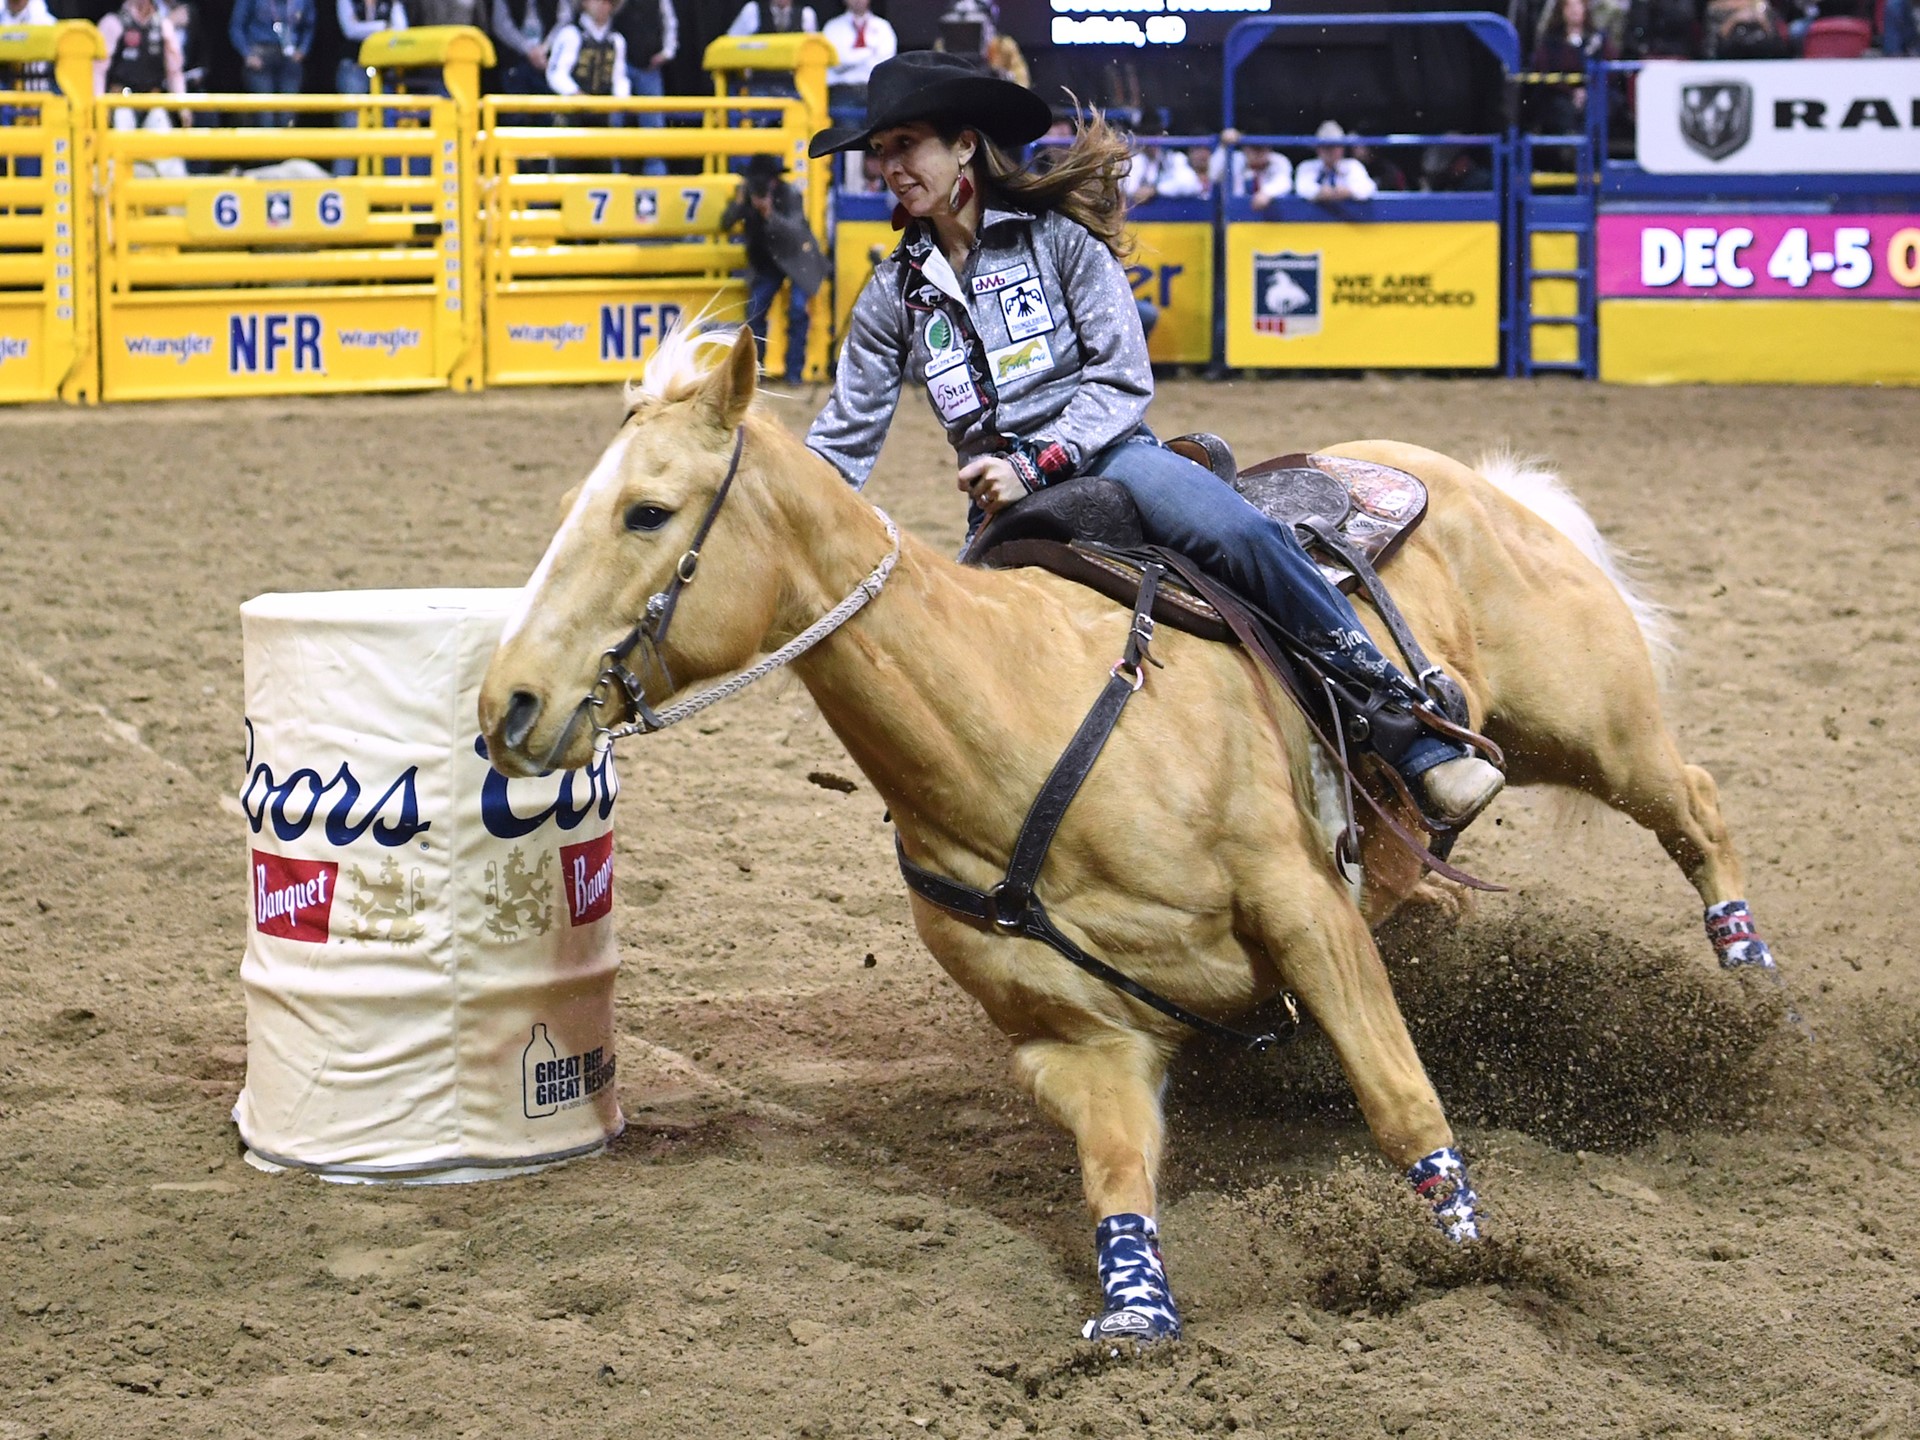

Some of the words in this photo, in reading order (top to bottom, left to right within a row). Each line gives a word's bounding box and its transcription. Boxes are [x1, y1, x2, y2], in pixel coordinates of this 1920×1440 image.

[214, 194, 239, 228] 6
[318, 191, 343, 225] 6
[589, 190, 610, 222] 7
[683, 190, 703, 221] 7
[1640, 227, 1754, 287] DEC
[1767, 227, 1873, 288] 4-5
[1333, 274, 1372, 288] WE
[1383, 274, 1432, 288] ARE
[1332, 292, 1475, 306] PRORODEO
[230, 314, 322, 371] NFR
[256, 864, 328, 927] Banquet
[535, 1055, 581, 1084] GREAT
[536, 1077, 581, 1106] GREAT
